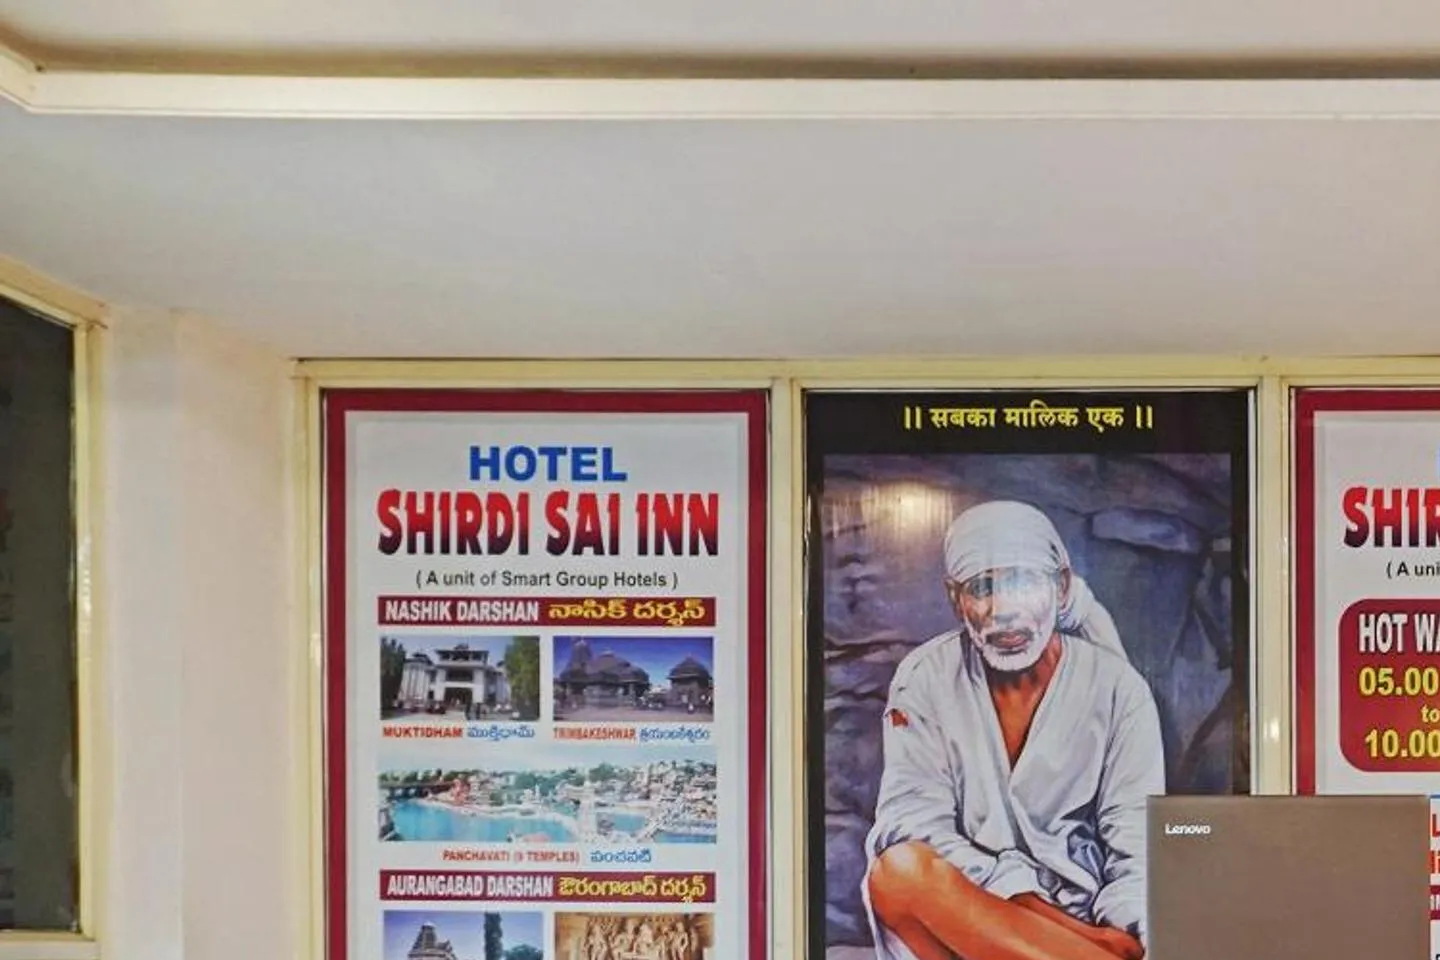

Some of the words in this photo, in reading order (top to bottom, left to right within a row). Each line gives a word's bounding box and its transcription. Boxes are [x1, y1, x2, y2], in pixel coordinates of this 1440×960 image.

[929, 408, 996, 428] सबका
[1003, 400, 1079, 428] मालिक
[1086, 407, 1124, 432] एक
[469, 446, 627, 481] HOTEL
[377, 489, 529, 556] SHIRDI
[545, 489, 621, 556] SAI
[636, 491, 720, 556] INN
[443, 571, 475, 586] unit
[480, 571, 497, 586] of
[502, 570, 550, 586] Smart
[556, 571, 608, 590] Group
[614, 571, 667, 587] Hotels
[385, 600, 452, 621] NASHIK
[456, 600, 539, 622] DARSHAN
[1358, 613, 1408, 653] HOT
[1359, 666, 1440, 697] 05.00
[1421, 704, 1440, 723] to
[383, 726, 463, 739] MUKTIDHAM
[553, 726, 636, 740] TRIMBAKESHWAR
[1165, 823, 1211, 835] Lenovo
[442, 849, 510, 863] PANCHAVATI
[387, 874, 484, 897] AURANGABAD
[487, 875, 553, 897] DARSHAN
